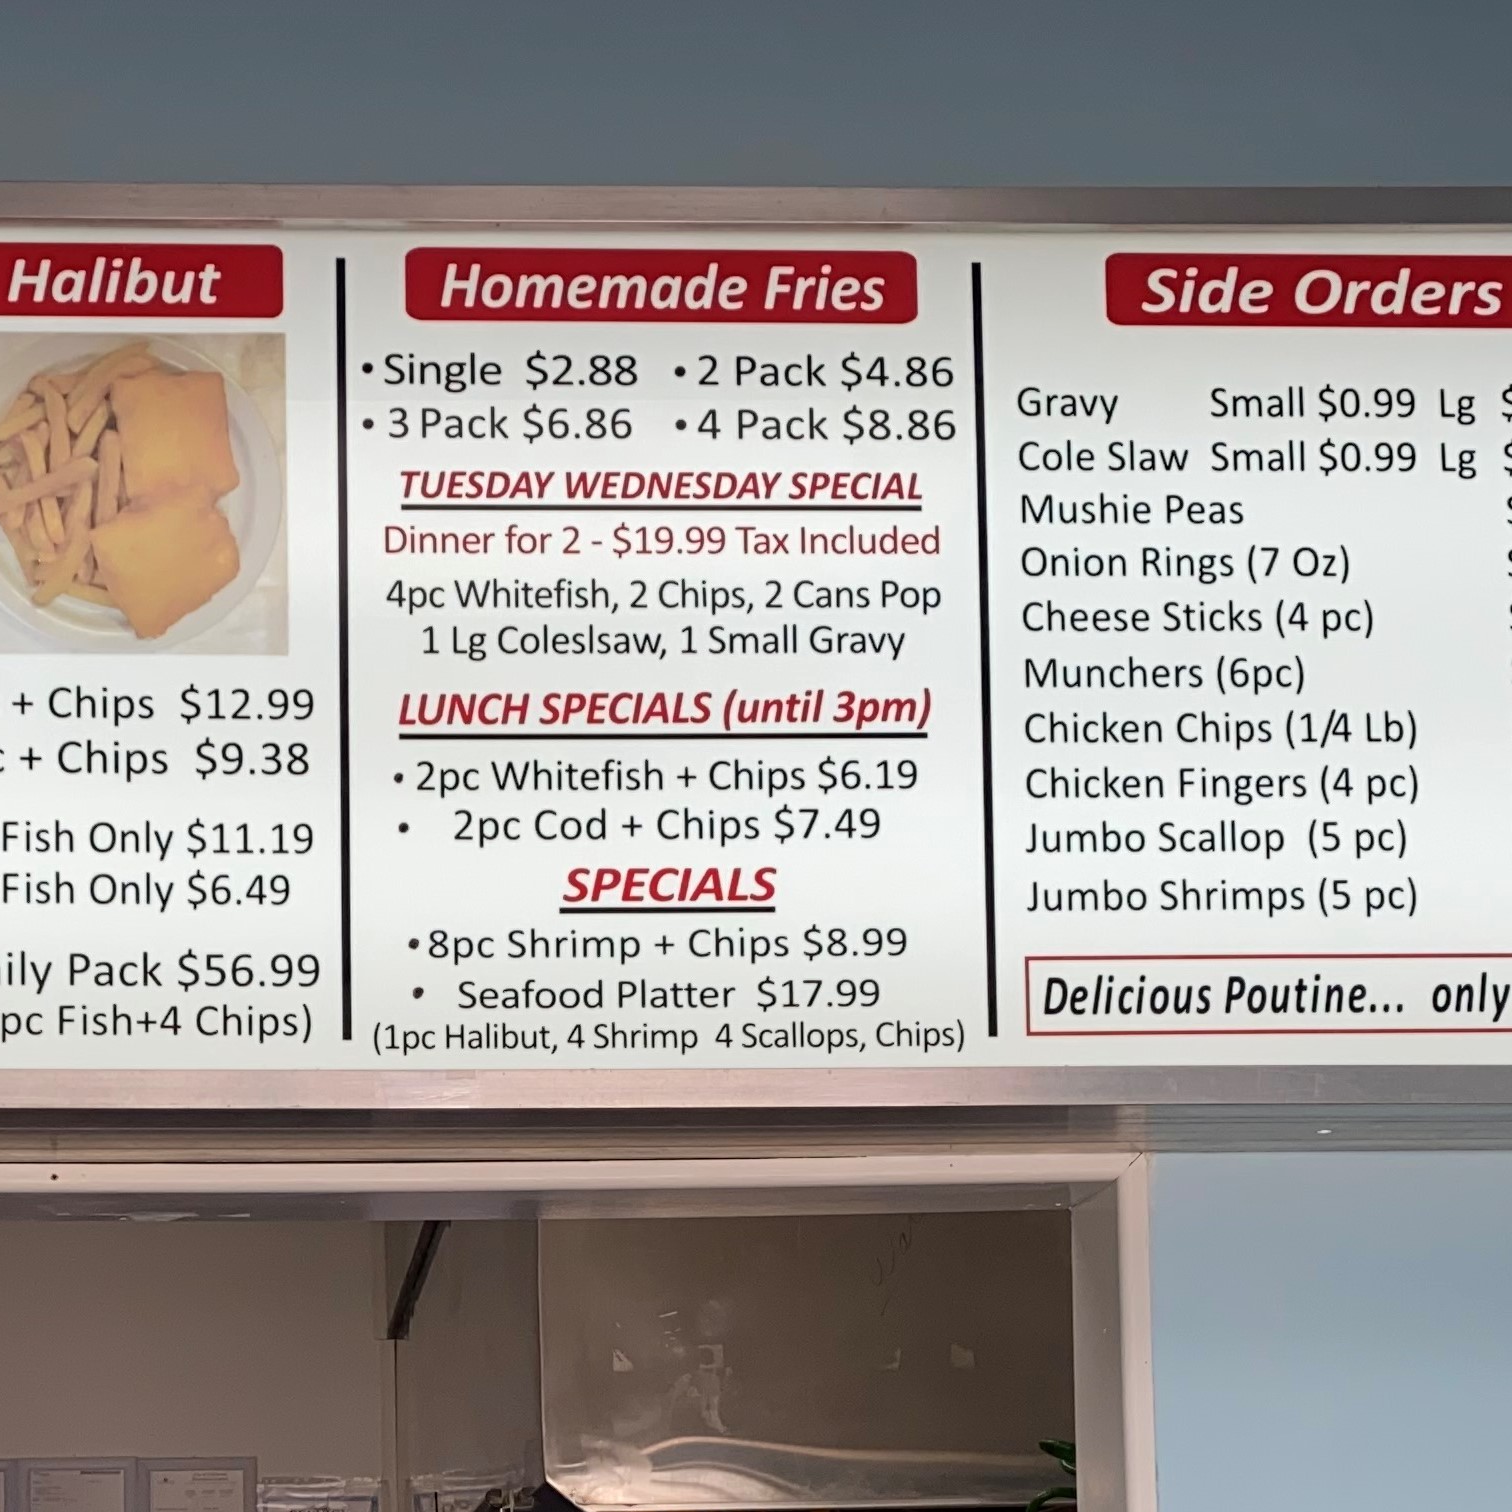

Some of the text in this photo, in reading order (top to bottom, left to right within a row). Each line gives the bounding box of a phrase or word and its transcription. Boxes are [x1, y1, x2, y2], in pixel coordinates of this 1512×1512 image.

[7, 256, 222, 305] Halibut
[440, 262, 885, 311] Homemade Fries
[1141, 266, 1503, 316] Side Orders
[1017, 383, 1476, 426] Gravy Small $0.99 Lg
[1018, 437, 1477, 480] Cole Slaw Small $0.99 Lg
[400, 470, 923, 500] TUESDAY WEDNESDAY SPECIAL
[1021, 492, 1244, 525] Mushie Peas
[384, 521, 940, 559] Dinner for 2 $19.99 Tax Included
[1021, 544, 1350, 585] Onion Rings (7 Oz)
[386, 578, 942, 616] 4pc Whitefish, 2 Chips, 2 Cans Pop
[1022, 599, 1373, 640] Cheese Sticks (4 pc)
[422, 623, 906, 662] 1 Lg Coleslsaw, 1 Small Gravy
[1025, 655, 1304, 696] Munchers (6pc)
[1024, 708, 1417, 751] Chicken Chips (1/4 Lb)
[57, 739, 168, 783] Chips
[195, 736, 310, 781] $9.38
[1026, 764, 1418, 806] Chicken Fingers (4 pc)
[1025, 818, 1407, 860] Jumbo Scallop (5 pc)
[1026, 876, 1417, 918] Jumbo Shrimps (5 pc)
[1043, 971, 1511, 1023] Delicious Poutine... only
[373, 1018, 965, 1057] (1pc Halibut, 4 Shrimp 4 Scallops, Chips)
